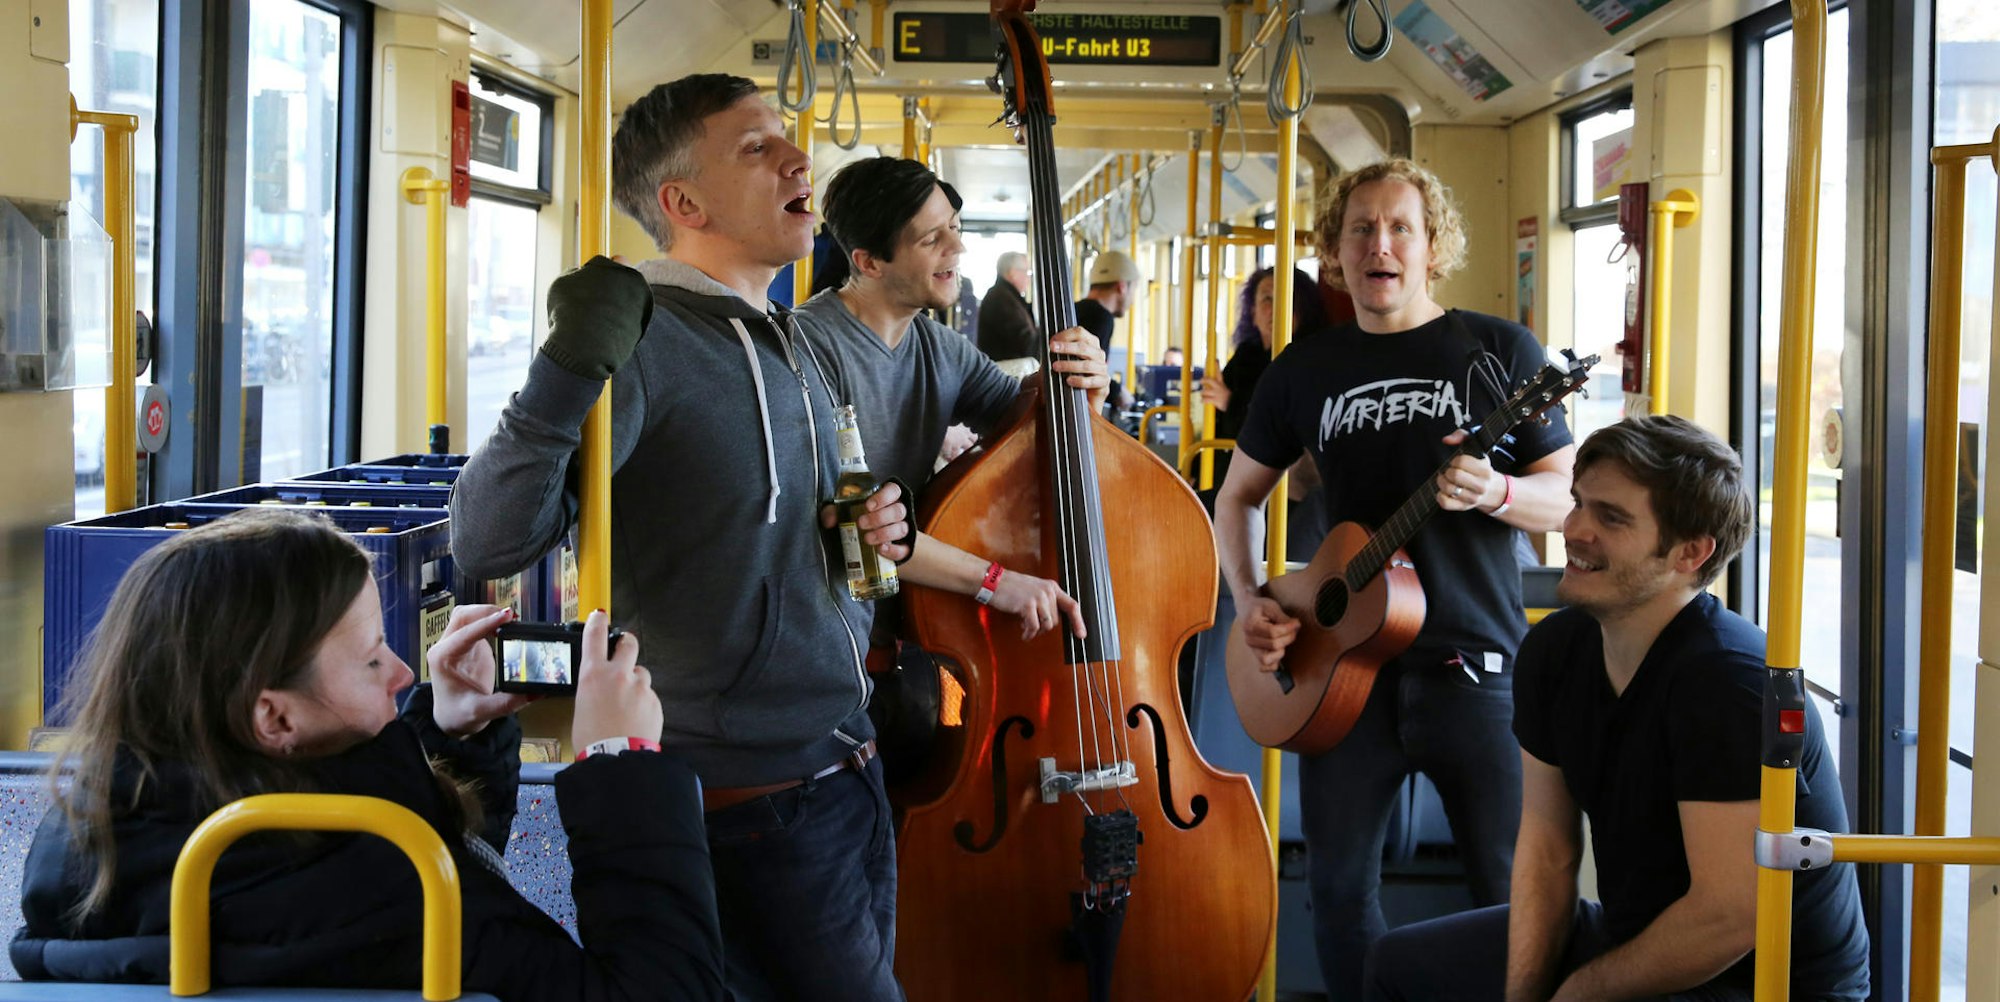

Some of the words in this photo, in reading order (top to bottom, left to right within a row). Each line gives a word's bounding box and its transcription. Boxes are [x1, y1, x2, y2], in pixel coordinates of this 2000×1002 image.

[1081, 15, 1190, 30] HALTESTELLE
[900, 20, 921, 54] E
[1042, 37, 1120, 57] U-Fahrt
[1126, 38, 1151, 57] U3
